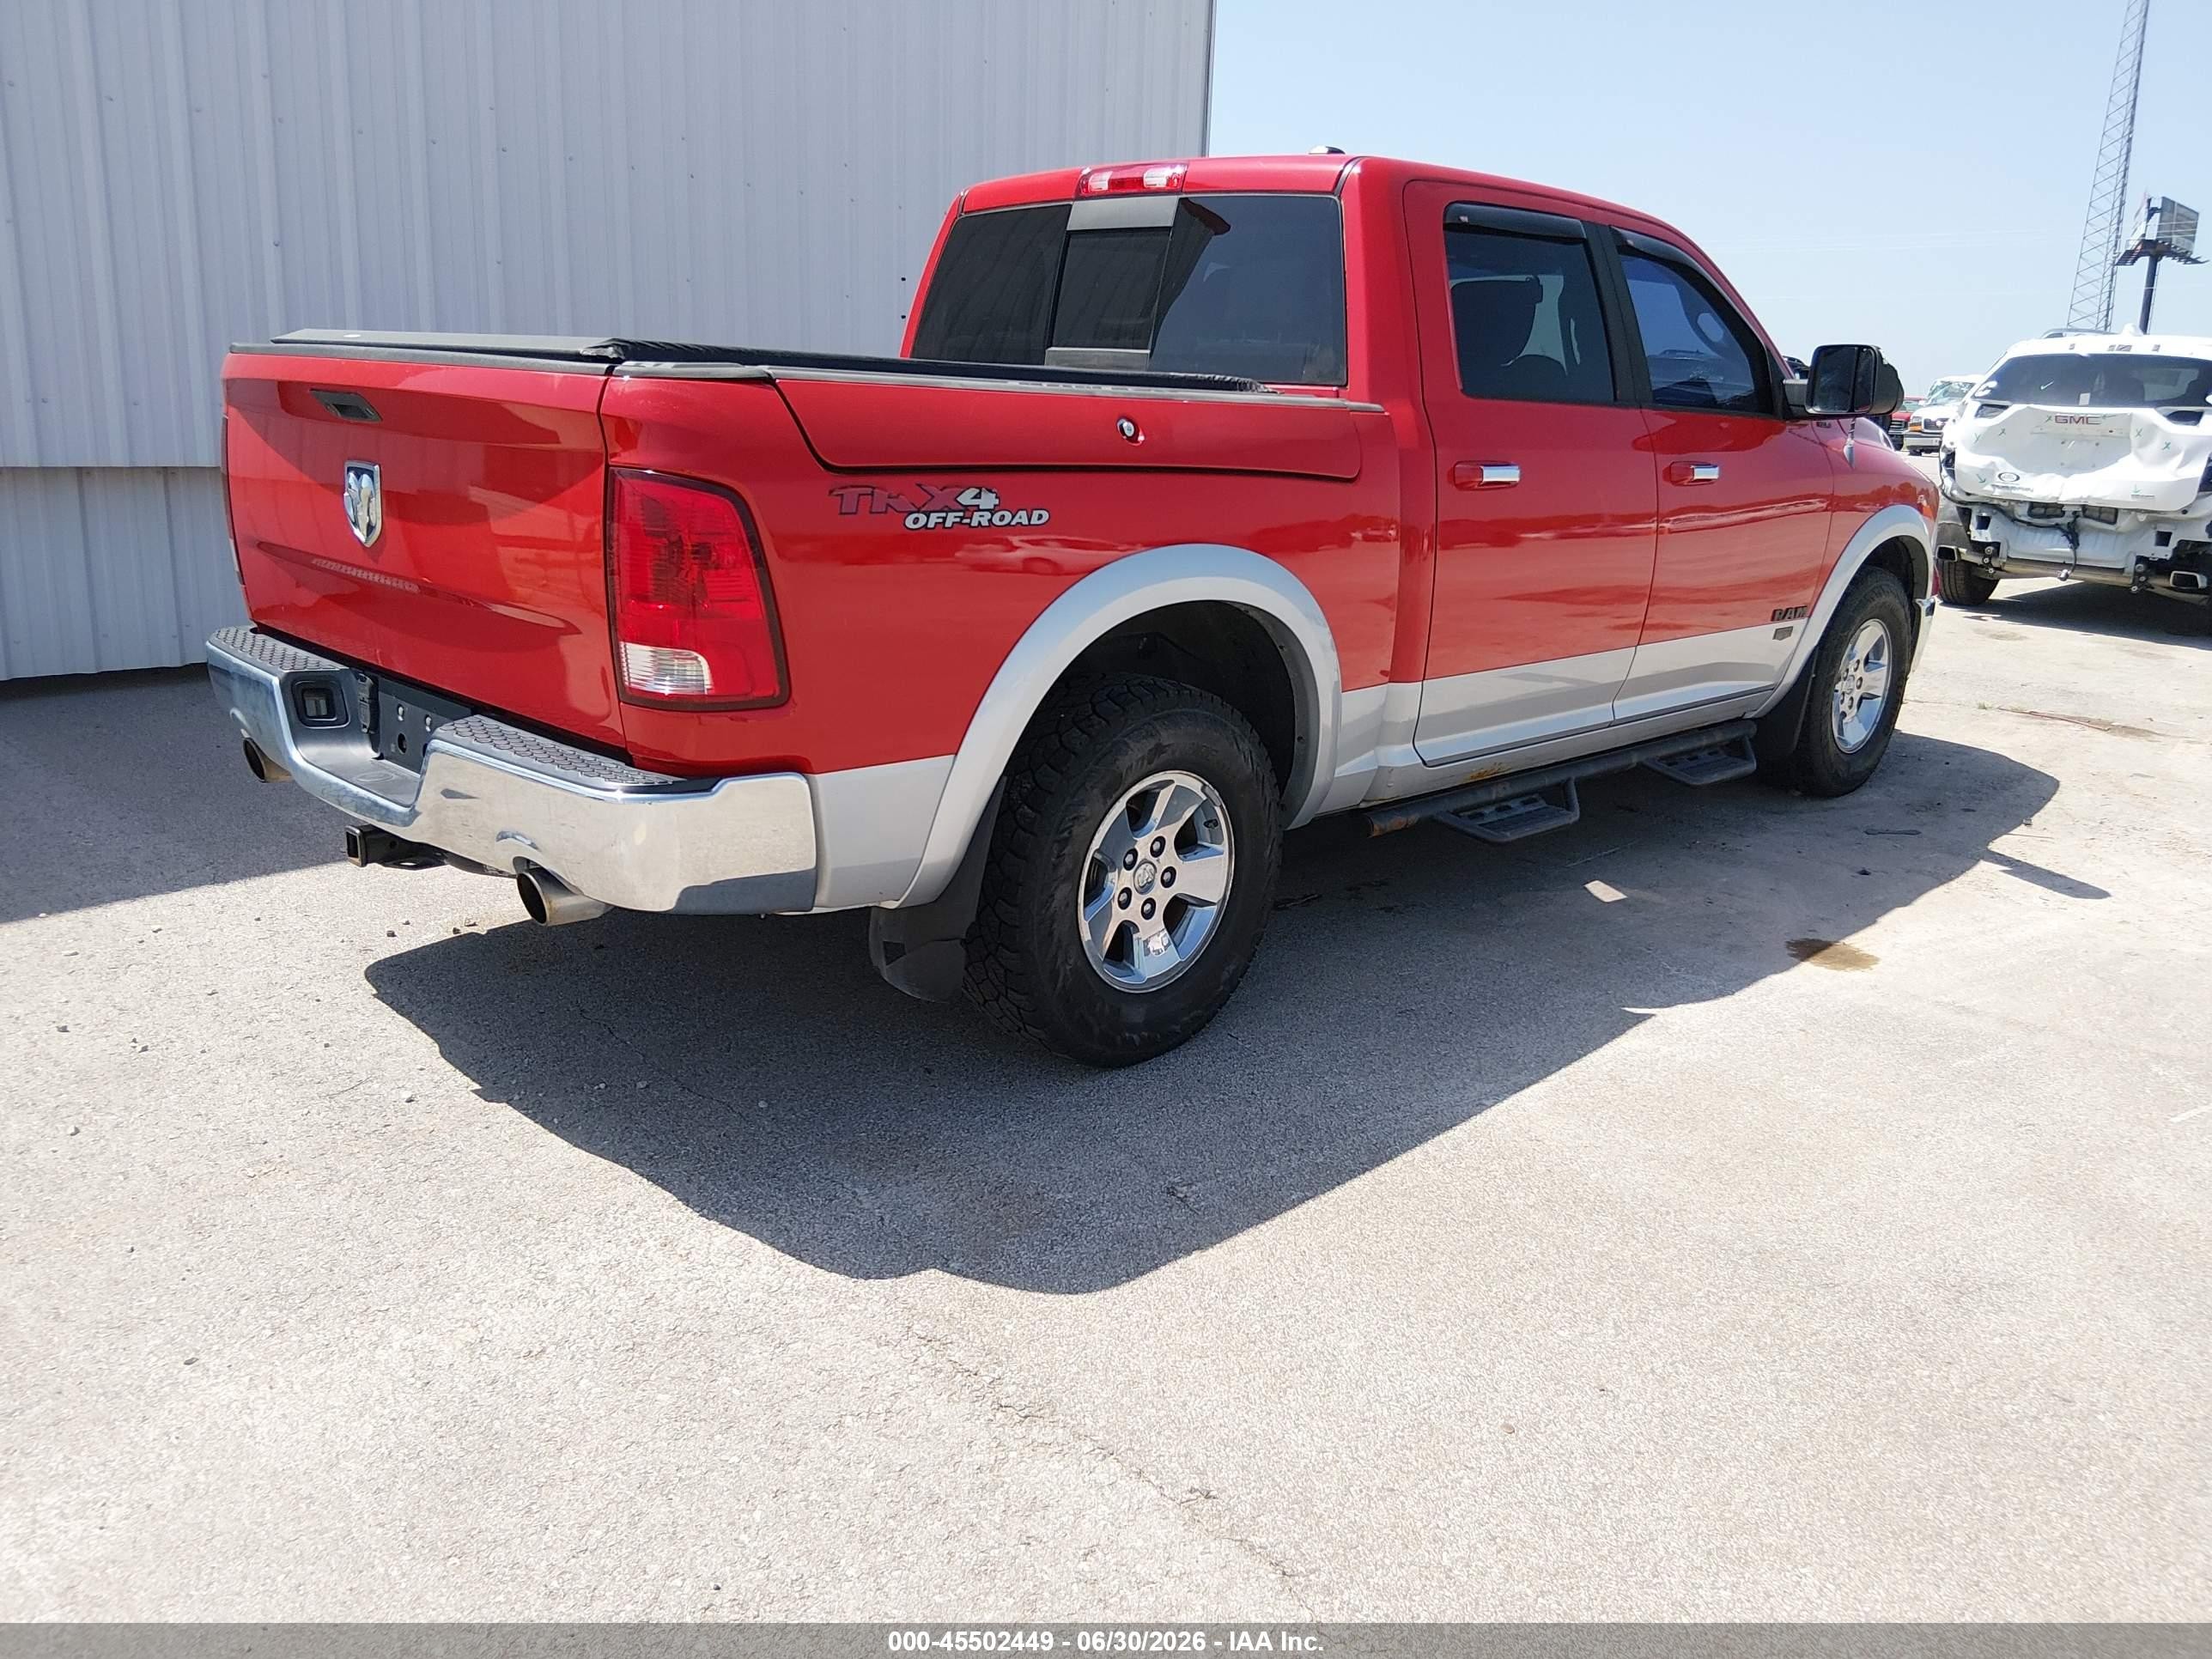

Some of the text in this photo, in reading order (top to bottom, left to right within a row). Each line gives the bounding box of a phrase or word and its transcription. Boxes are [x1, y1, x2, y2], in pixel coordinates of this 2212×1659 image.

[2054, 415, 2101, 425] GMC
[904, 508, 1050, 531] OFF-ROAD
[1771, 605, 1808, 622] RAM
